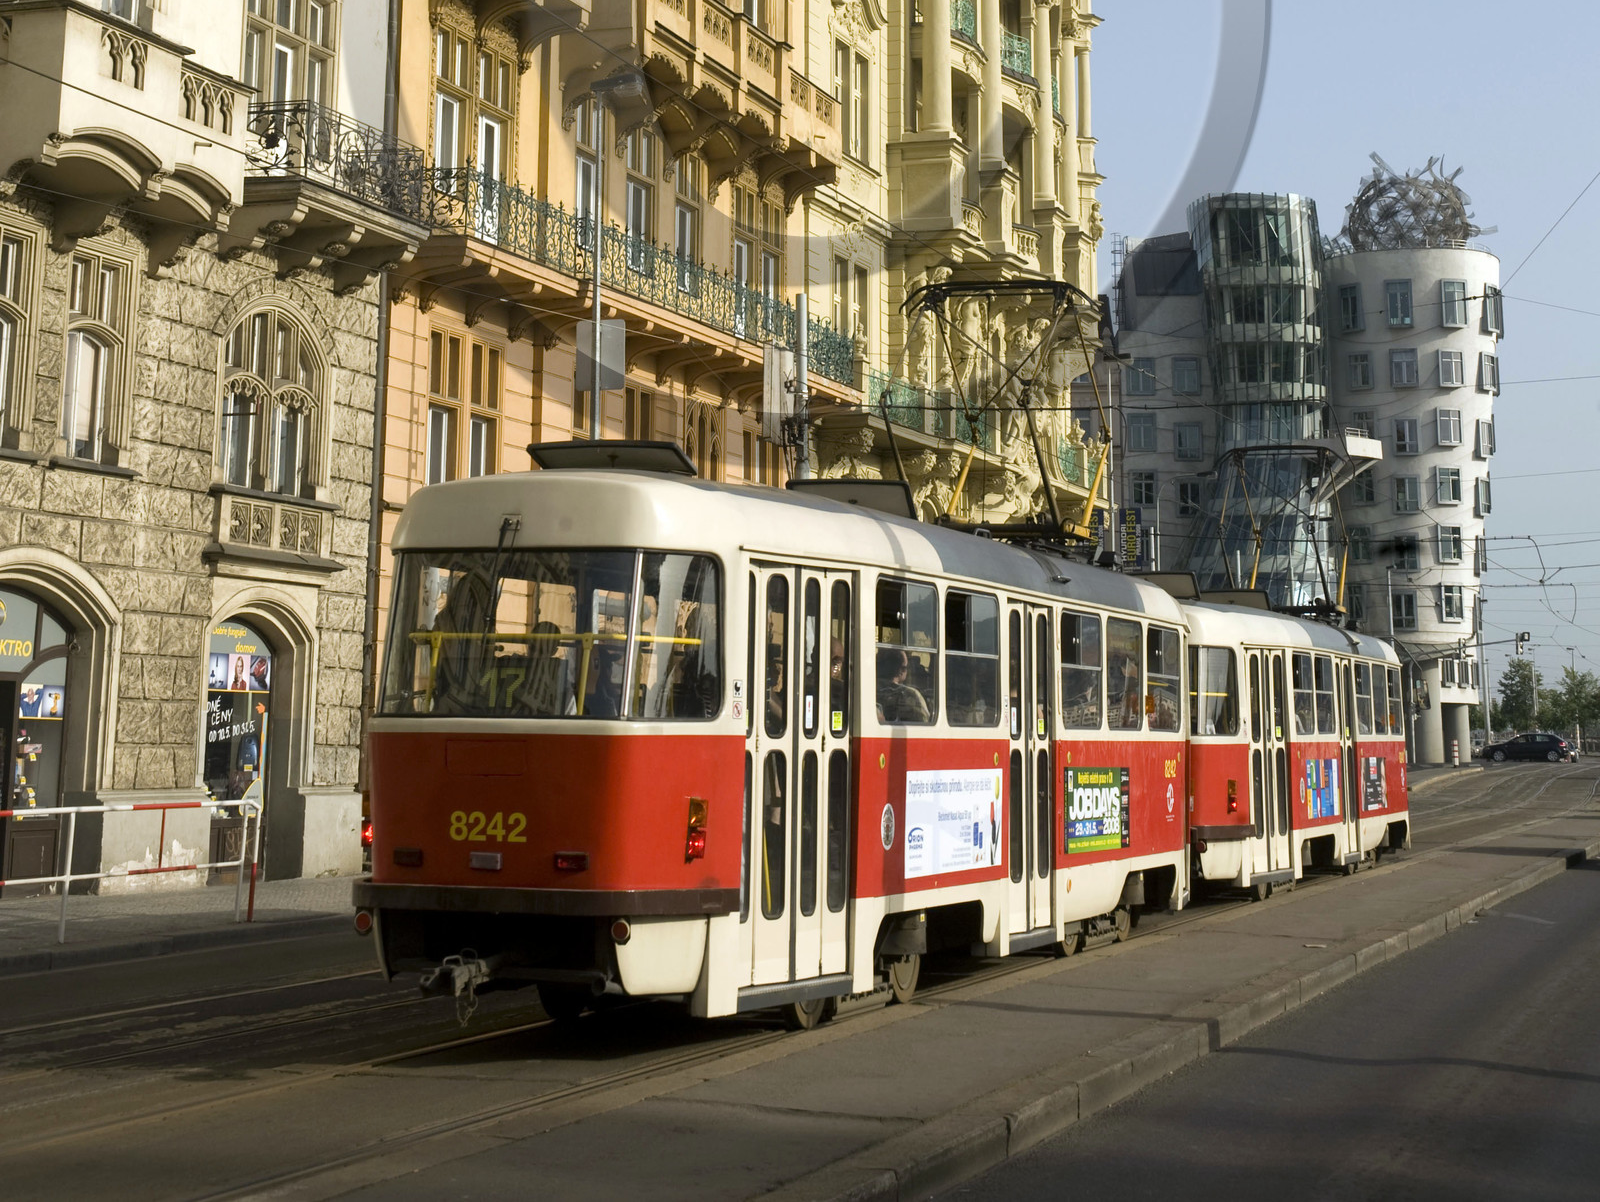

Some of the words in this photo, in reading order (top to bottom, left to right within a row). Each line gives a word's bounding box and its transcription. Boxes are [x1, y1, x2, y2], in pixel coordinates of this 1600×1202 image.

[1126, 510, 1136, 532] FEST
[1127, 535, 1136, 561] EURO
[0, 639, 32, 657] KTRO
[235, 642, 256, 653] domov
[479, 667, 526, 708] 17
[211, 708, 233, 726] CENY
[208, 729, 217, 743] OD
[232, 724, 240, 737] DO
[1165, 759, 1176, 778] 8242
[450, 810, 527, 842] 8242
[1103, 816, 1120, 835] 2008
[908, 827, 924, 844] ORION
